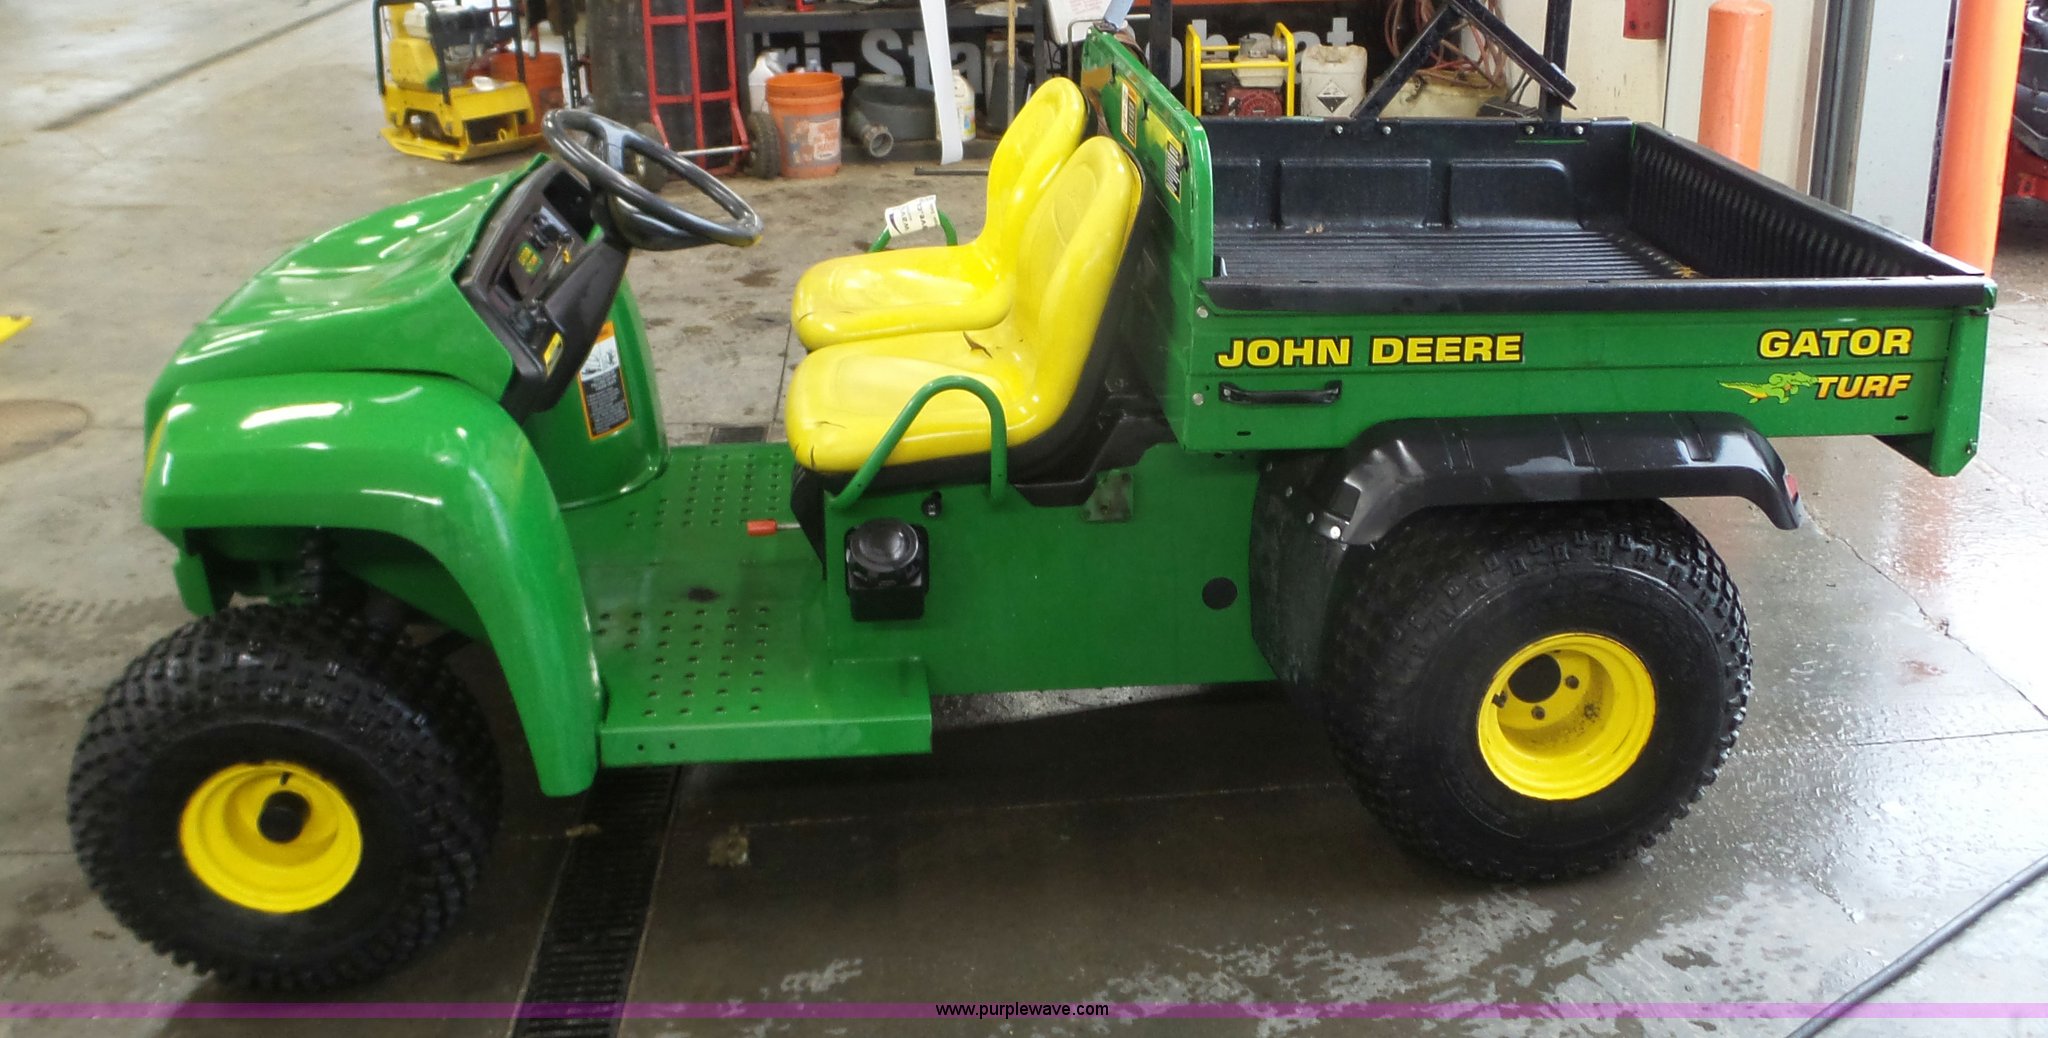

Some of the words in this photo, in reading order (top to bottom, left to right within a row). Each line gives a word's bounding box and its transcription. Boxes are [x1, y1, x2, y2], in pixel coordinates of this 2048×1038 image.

[1216, 336, 1351, 368] JOHN
[1369, 332, 1523, 365] DEERE
[1757, 328, 1913, 359] GATOR
[1814, 373, 1913, 400] TURF
